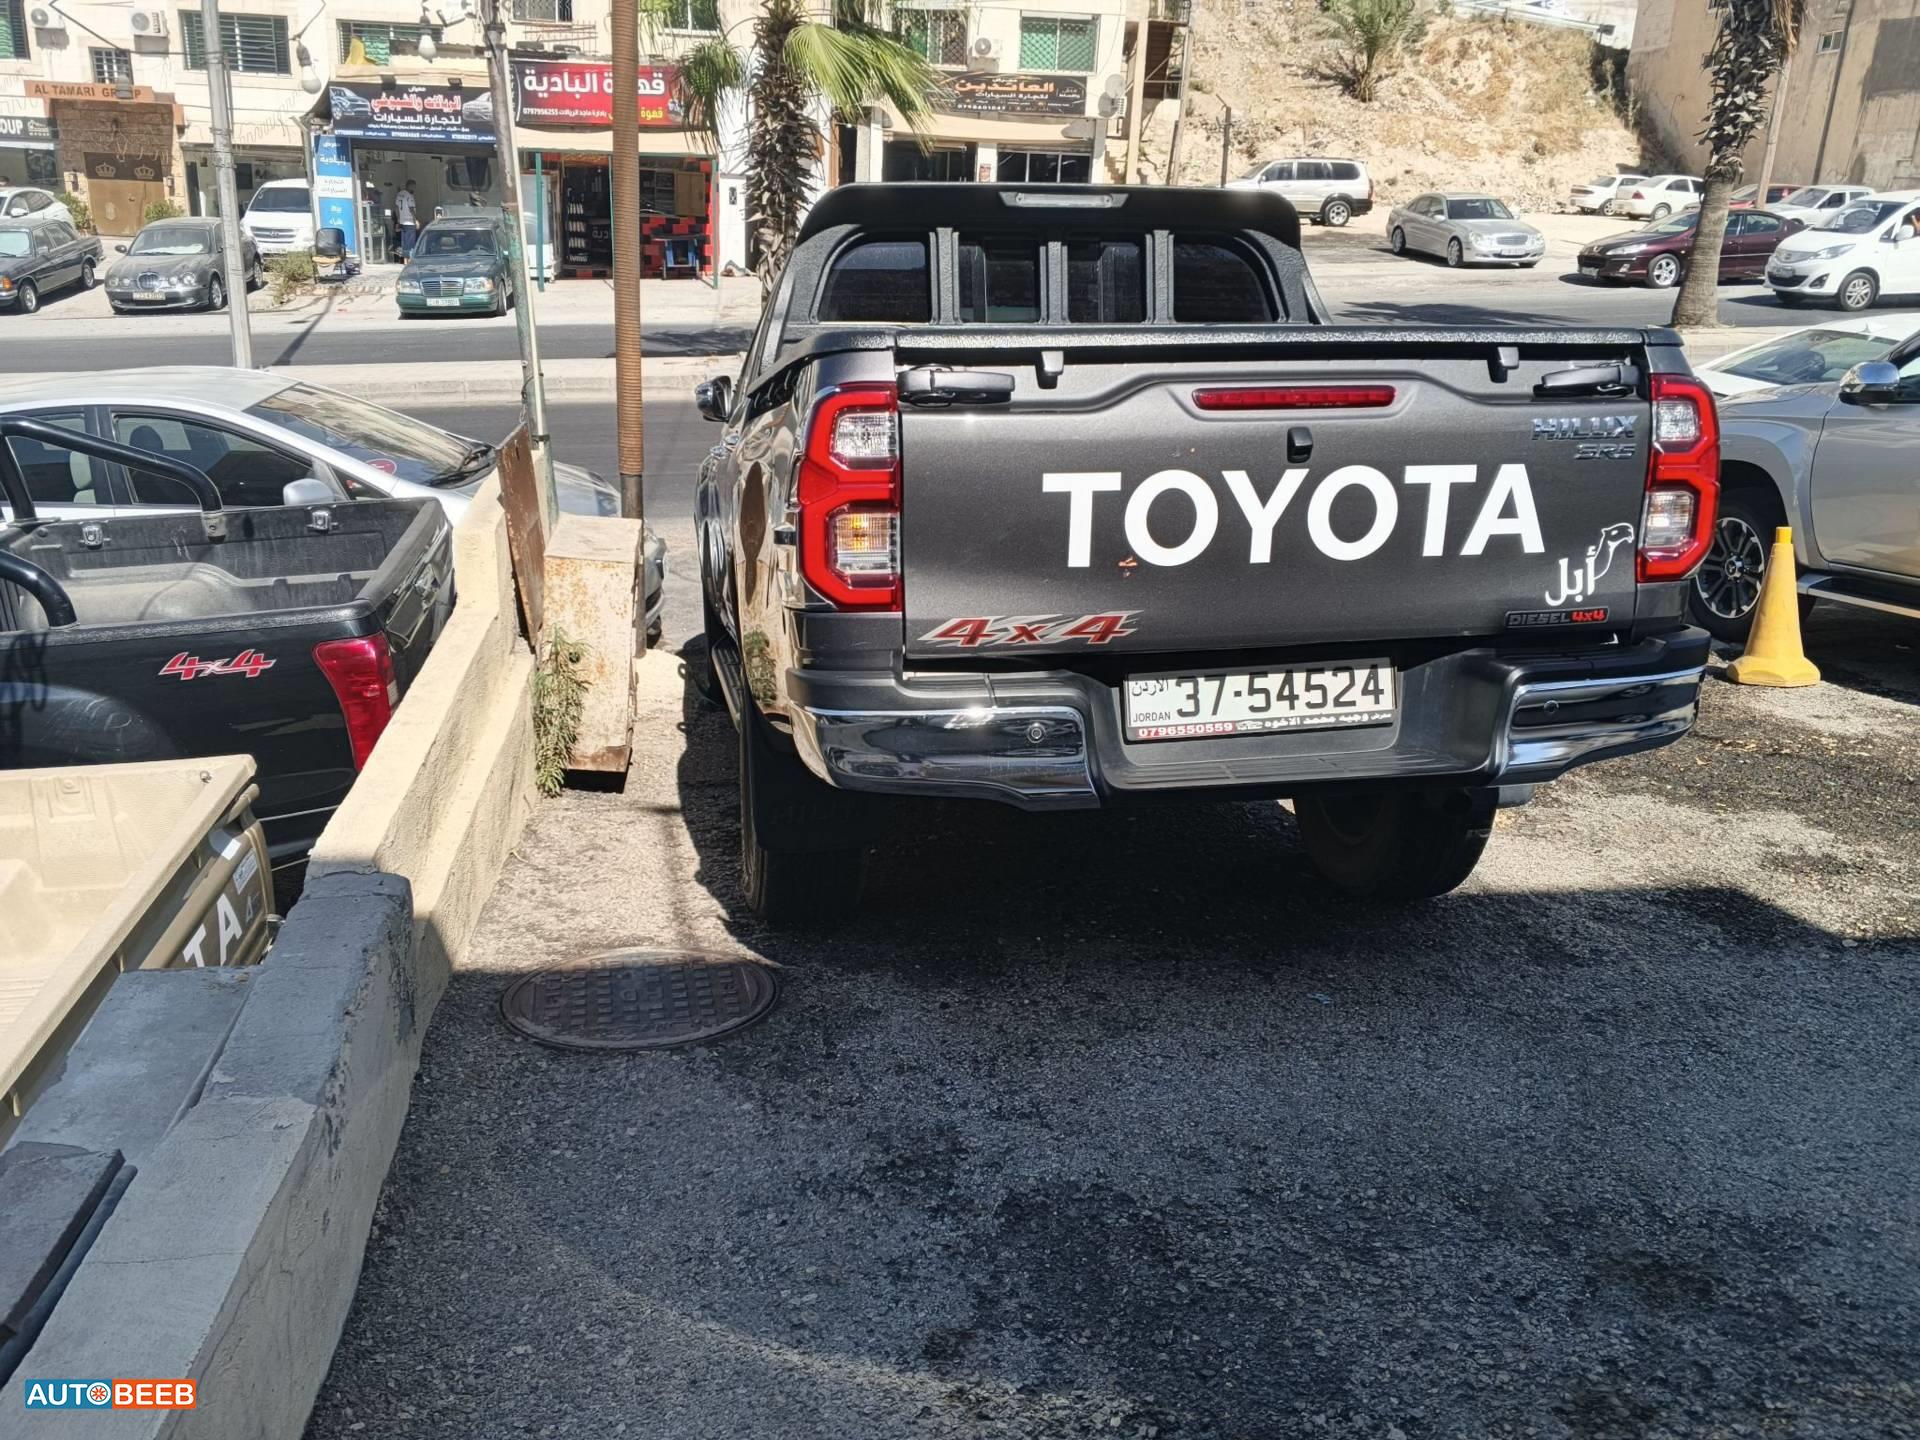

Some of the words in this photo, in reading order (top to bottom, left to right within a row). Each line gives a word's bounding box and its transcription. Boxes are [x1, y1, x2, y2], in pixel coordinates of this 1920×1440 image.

[34, 84, 48, 95] AL
[52, 85, 95, 97] TAMARI
[102, 88, 141, 99] GRP
[524, 68, 597, 98] البادية
[603, 72, 665, 95] قهة
[373, 112, 424, 124] السيارات
[424, 114, 462, 126] لتجارة
[640, 106, 664, 120] قهوة
[1531, 415, 1639, 441] HILUX
[1041, 463, 1546, 569] TOYOTA
[1507, 611, 1570, 626] DIESEL
[1571, 608, 1606, 623] 4x4
[920, 611, 1140, 648] 4x4
[158, 648, 278, 681] 4x4
[1132, 711, 1171, 723] JORDAN
[1303, 713, 1336, 726] محمد
[1138, 721, 1234, 738] 0796550559
